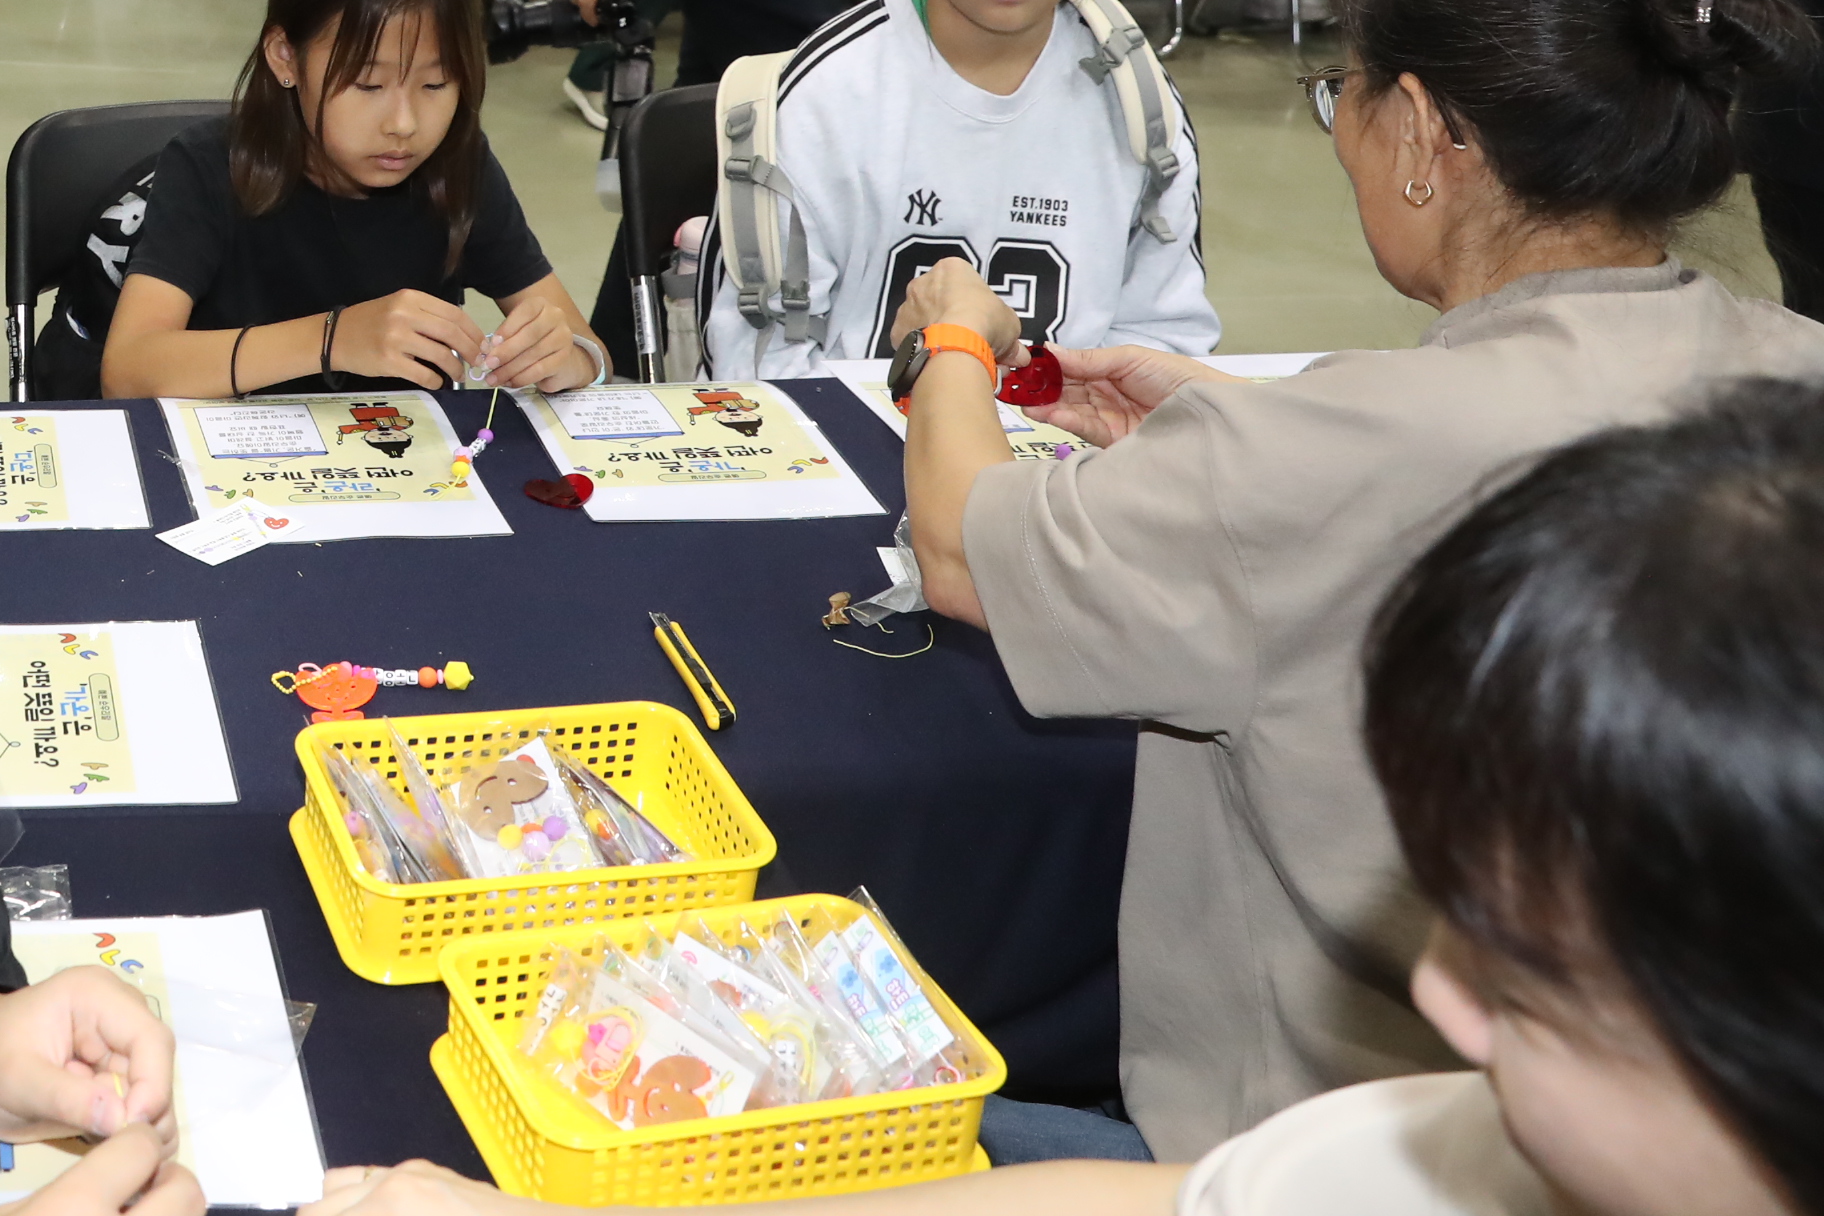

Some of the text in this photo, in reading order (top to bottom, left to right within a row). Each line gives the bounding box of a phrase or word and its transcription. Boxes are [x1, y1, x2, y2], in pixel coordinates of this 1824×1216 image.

[1012, 196, 1069, 212] EST.1903
[1010, 211, 1067, 227] YANKEES
[608, 446, 772, 462] 어떤 뜻일 까요?
[243, 467, 413, 481] 어떤 뜻일 까요?
[23, 661, 59, 767] 어떤 뜻일 까요?
[99, 701, 111, 720] 순우리말
